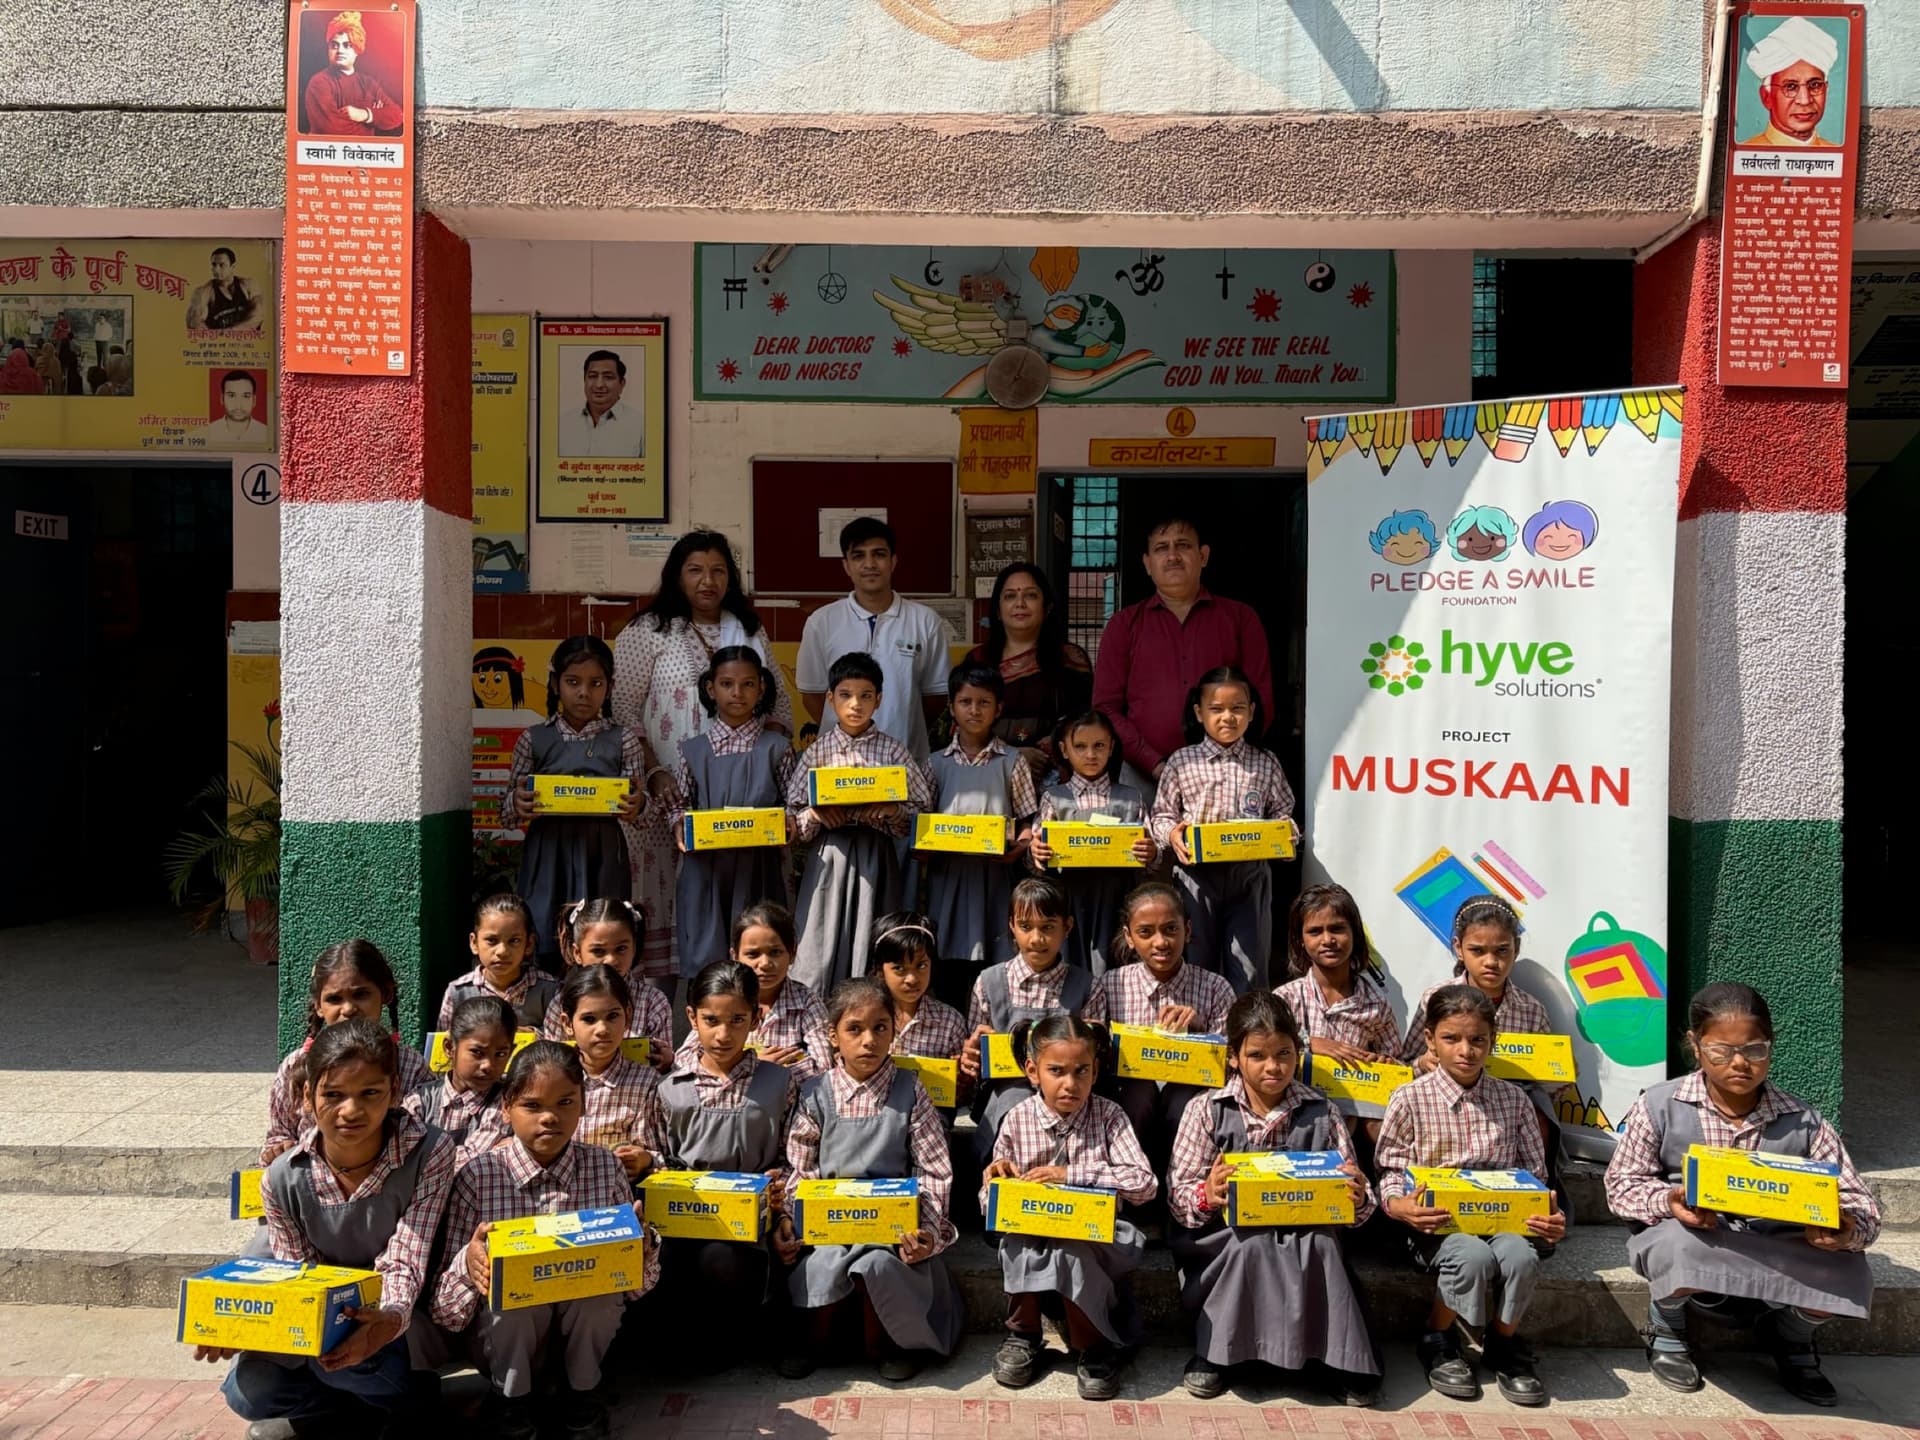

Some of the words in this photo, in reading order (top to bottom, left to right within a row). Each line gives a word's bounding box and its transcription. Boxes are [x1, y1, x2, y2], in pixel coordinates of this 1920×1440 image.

[305, 145, 336, 161] स्वामी
[343, 145, 396, 163] विवेकानंद
[1741, 154, 1780, 170] सर्वपल्ली
[1785, 159, 1835, 174] राधाकृष्णन
[50, 247, 77, 280] के
[83, 250, 128, 293] पूर्व
[135, 264, 189, 300] छात्र
[753, 336, 799, 356] DEAR
[806, 336, 875, 354] DOCTORS
[1184, 337, 1212, 359] WE
[1215, 337, 1246, 358] SEE
[1251, 336, 1281, 357] THE
[1286, 336, 1330, 356] REAL
[759, 362, 791, 381] AND
[796, 361, 861, 381] NURSES
[1164, 365, 1202, 388] GOD
[1209, 365, 1230, 386] IN
[1274, 364, 1323, 384] Thank
[970, 416, 1026, 442] प्रधानाचार्य
[1173, 411, 1188, 433] 4
[962, 448, 977, 473] श्री
[1111, 441, 1227, 462] कार्यालय-I
[251, 470, 271, 500] 4
[23, 515, 58, 537] EXIT
[1370, 570, 1473, 592] PLEDGE
[1482, 570, 1499, 590] A
[1508, 567, 1596, 589] SMILE
[1442, 596, 1517, 606] FOUNDATION
[1441, 629, 1574, 686] hyve
[1495, 678, 1596, 697] solutions
[1442, 730, 1511, 743] PROJECT
[1332, 755, 1630, 807] MUSKAAN
[1493, 1042, 1533, 1055] EVORD
[1727, 1176, 1790, 1195] REVORD
[668, 1200, 719, 1214] REVORD
[828, 1209, 878, 1220] REVORD
[1021, 1199, 1074, 1215] REVORD
[533, 1258, 597, 1278] REVORD
[214, 1297, 275, 1315] REVORD
[288, 1326, 305, 1334] FEEL
